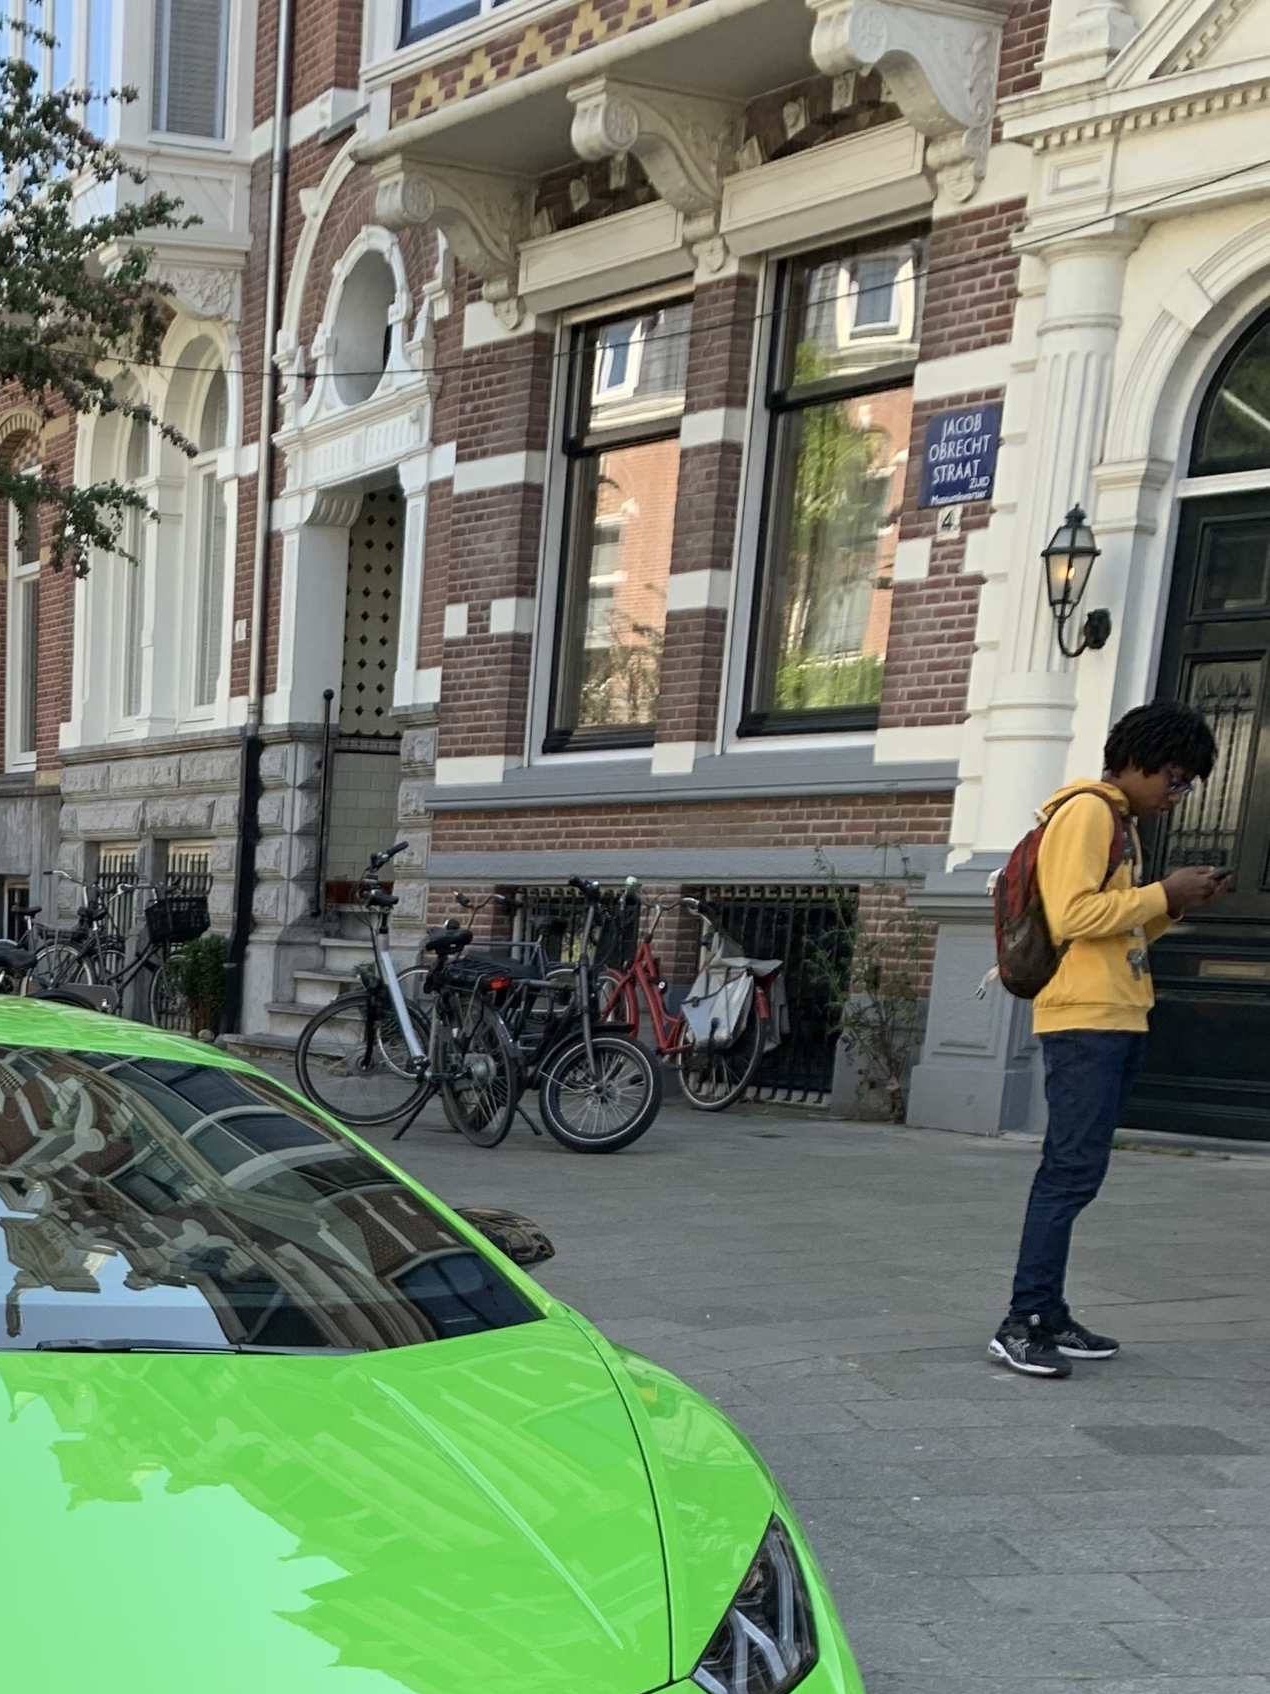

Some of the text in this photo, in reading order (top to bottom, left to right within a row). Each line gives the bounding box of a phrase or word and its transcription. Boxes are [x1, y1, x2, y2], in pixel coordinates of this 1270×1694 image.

[941, 413, 982, 443] JACOB
[929, 434, 992, 462] OBRECHT
[932, 459, 981, 485] STRAAT
[969, 475, 990, 489] ZUID
[930, 490, 988, 506] Museumkwartier
[941, 509, 953, 531] 4
